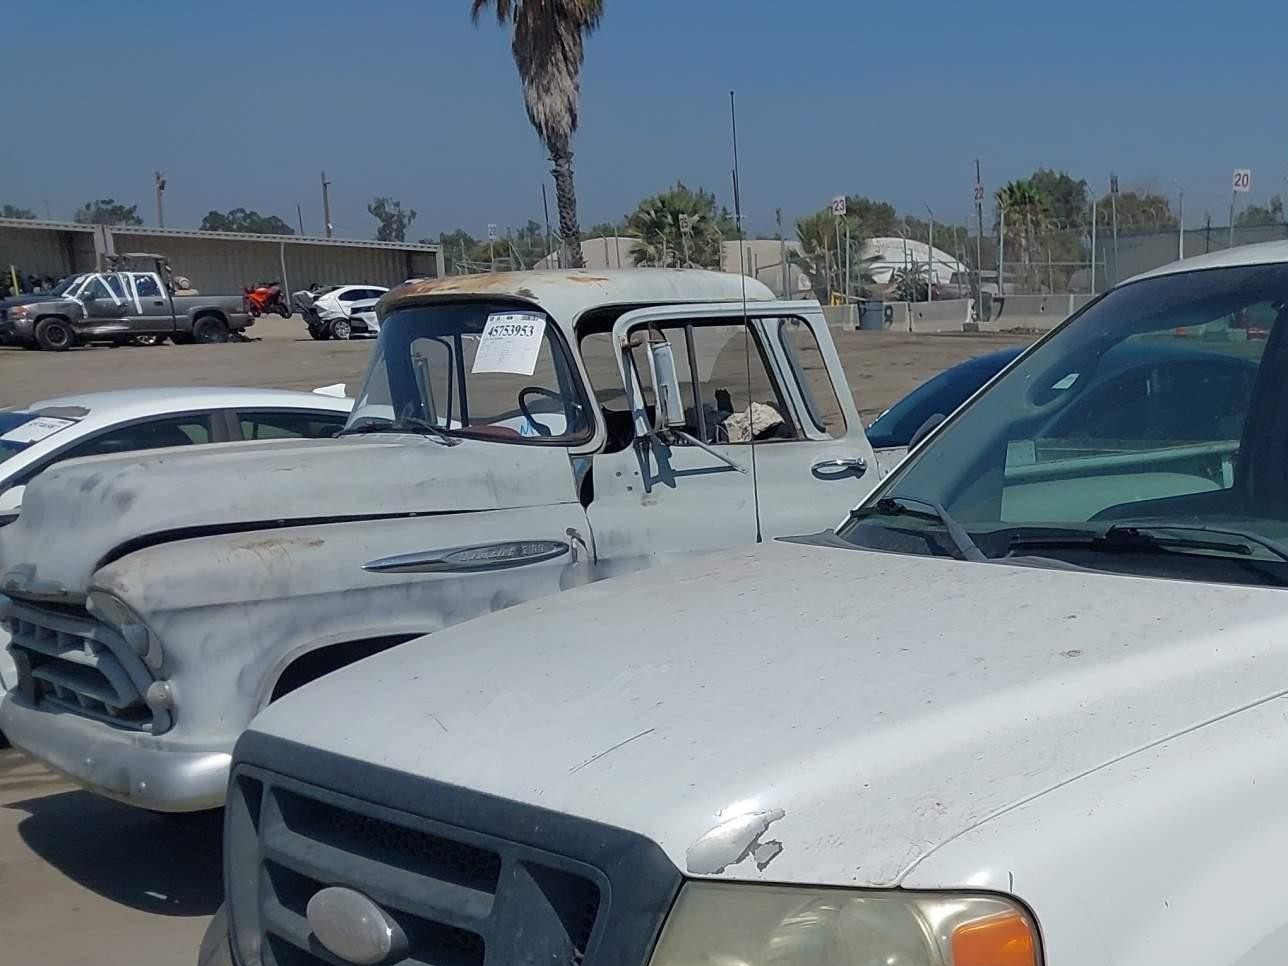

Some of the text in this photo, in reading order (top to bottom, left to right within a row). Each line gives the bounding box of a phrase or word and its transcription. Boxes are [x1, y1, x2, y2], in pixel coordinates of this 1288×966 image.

[1234, 173, 1249, 188] 20
[974, 187, 984, 200] 22
[834, 199, 845, 212] 23
[487, 324, 535, 338] 45753953
